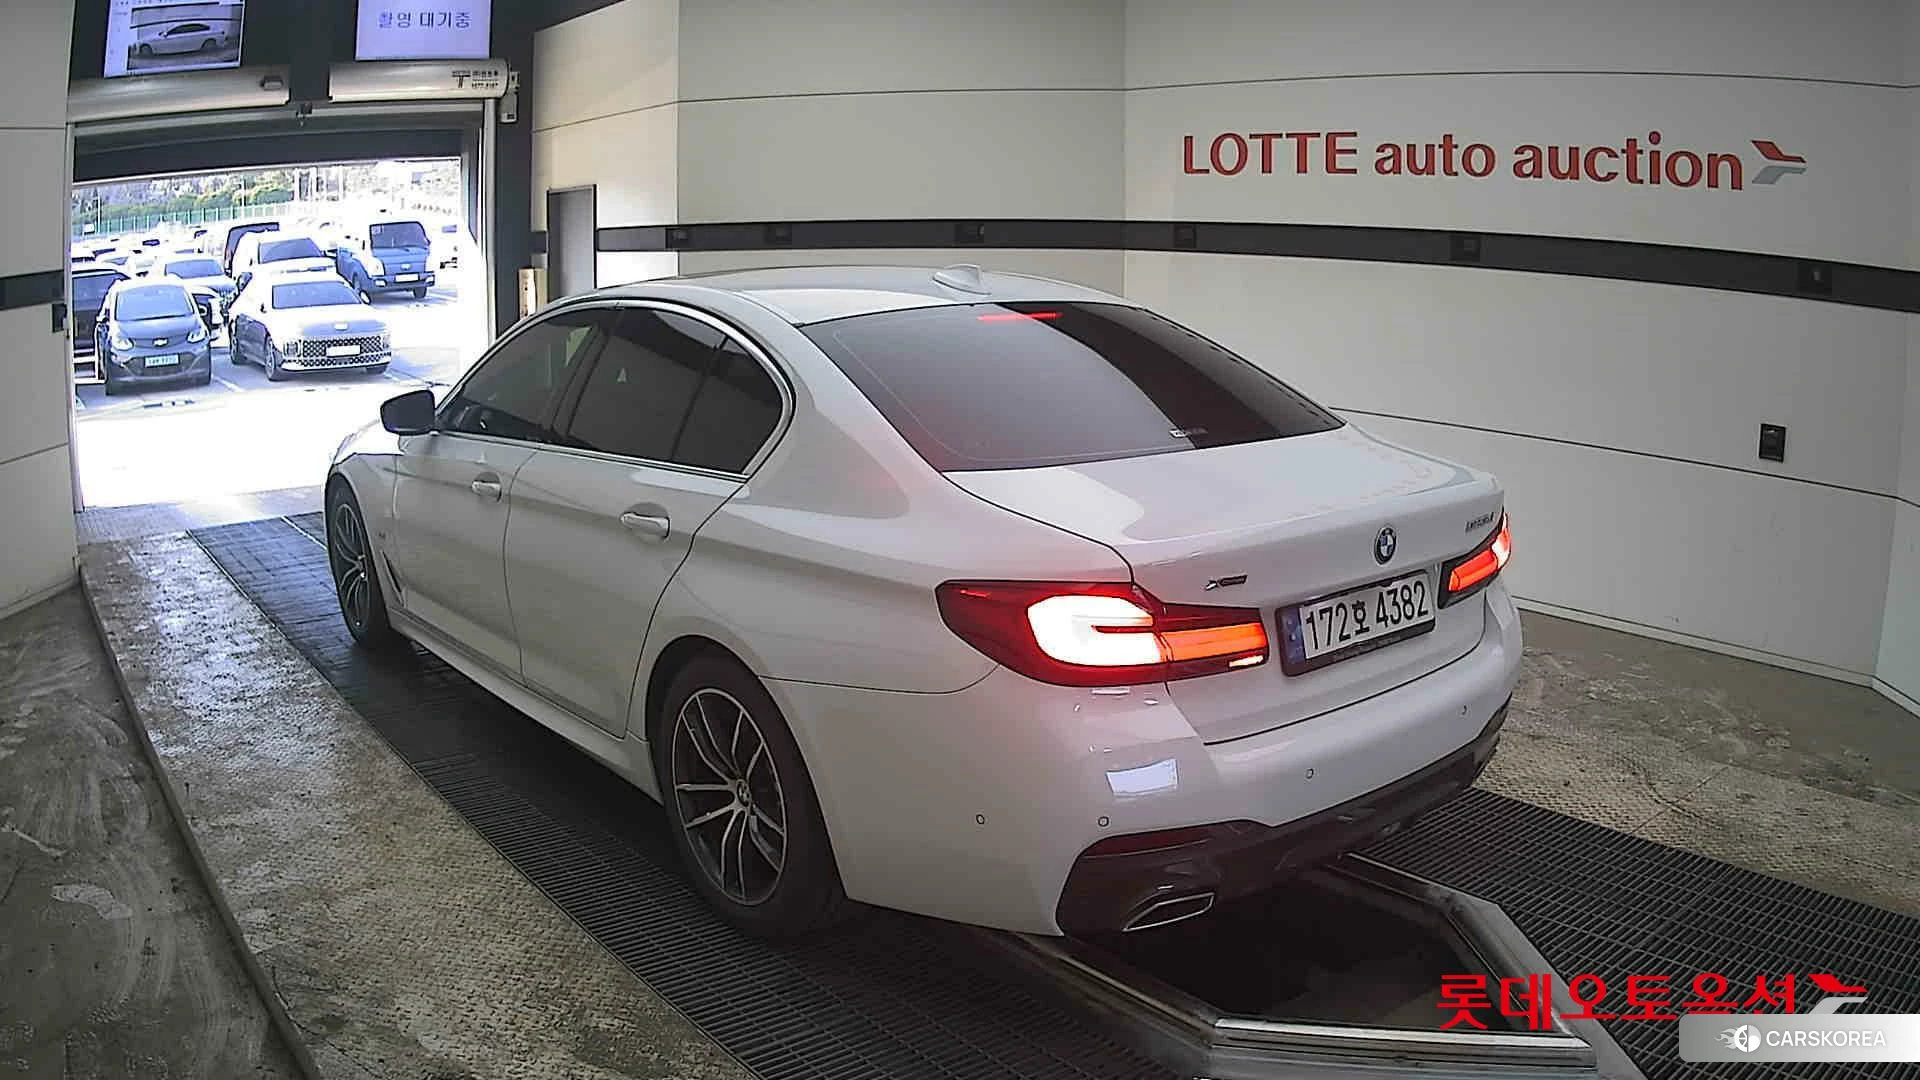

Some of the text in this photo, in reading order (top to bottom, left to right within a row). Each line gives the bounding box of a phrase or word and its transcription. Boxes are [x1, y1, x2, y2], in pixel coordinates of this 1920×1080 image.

[419, 11, 472, 29] 대기중
[1184, 131, 1743, 190] LOTTE auto auction
[1305, 600, 1371, 651] 172호
[1375, 580, 1429, 628] 4382
